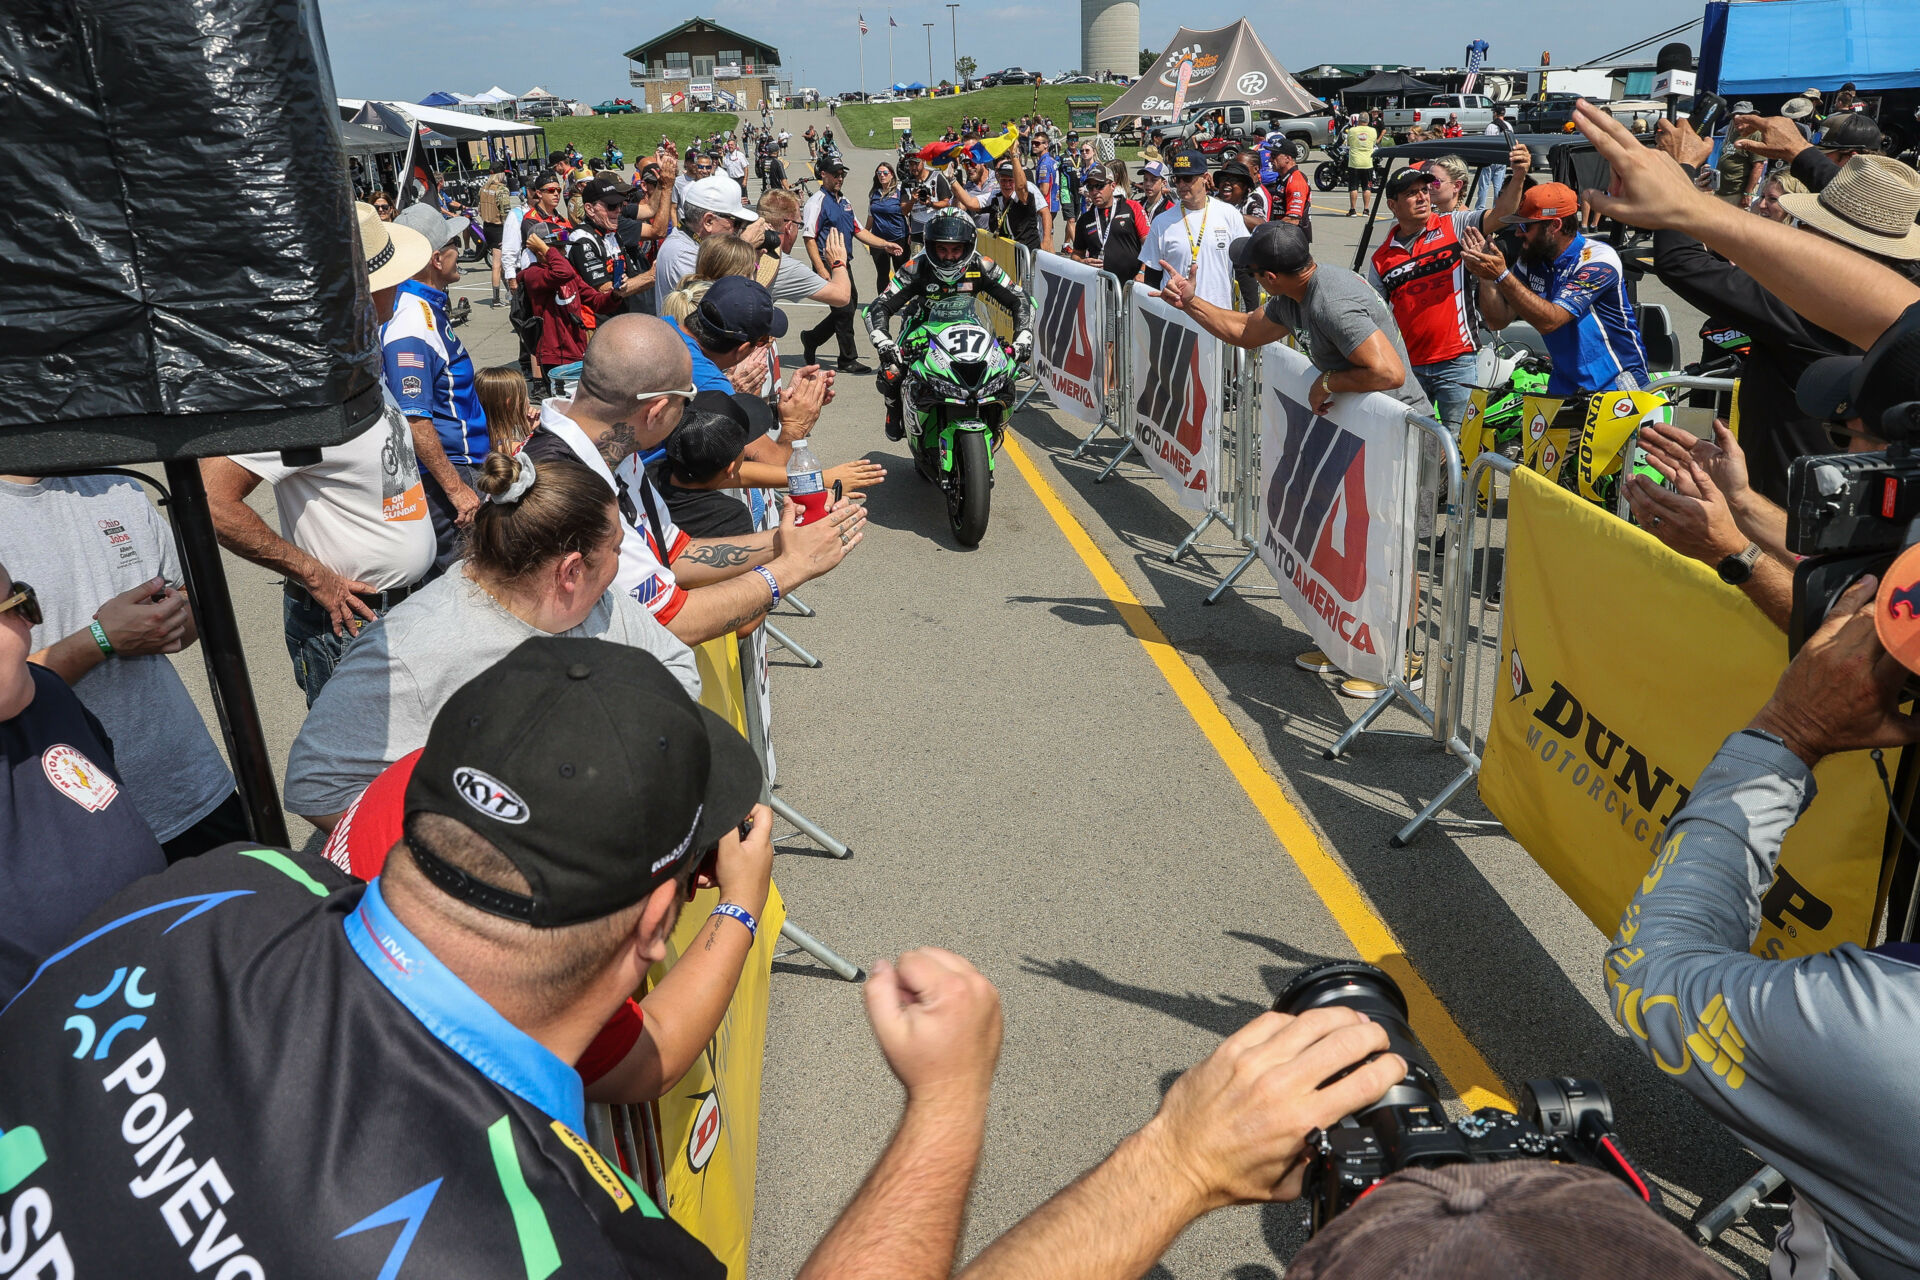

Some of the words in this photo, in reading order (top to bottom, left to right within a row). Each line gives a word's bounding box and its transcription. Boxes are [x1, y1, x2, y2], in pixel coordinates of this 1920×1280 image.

[949, 329, 985, 354] 37
[1580, 395, 1604, 484] UNLOP
[383, 500, 405, 513] ANY
[391, 493, 405, 503] ON
[383, 503, 417, 521] SUNDAY
[98, 519, 120, 529] Ohio
[109, 534, 131, 545] Jobs
[1264, 525, 1376, 655] MTOAMERICA
[458, 772, 519, 817] KYT
